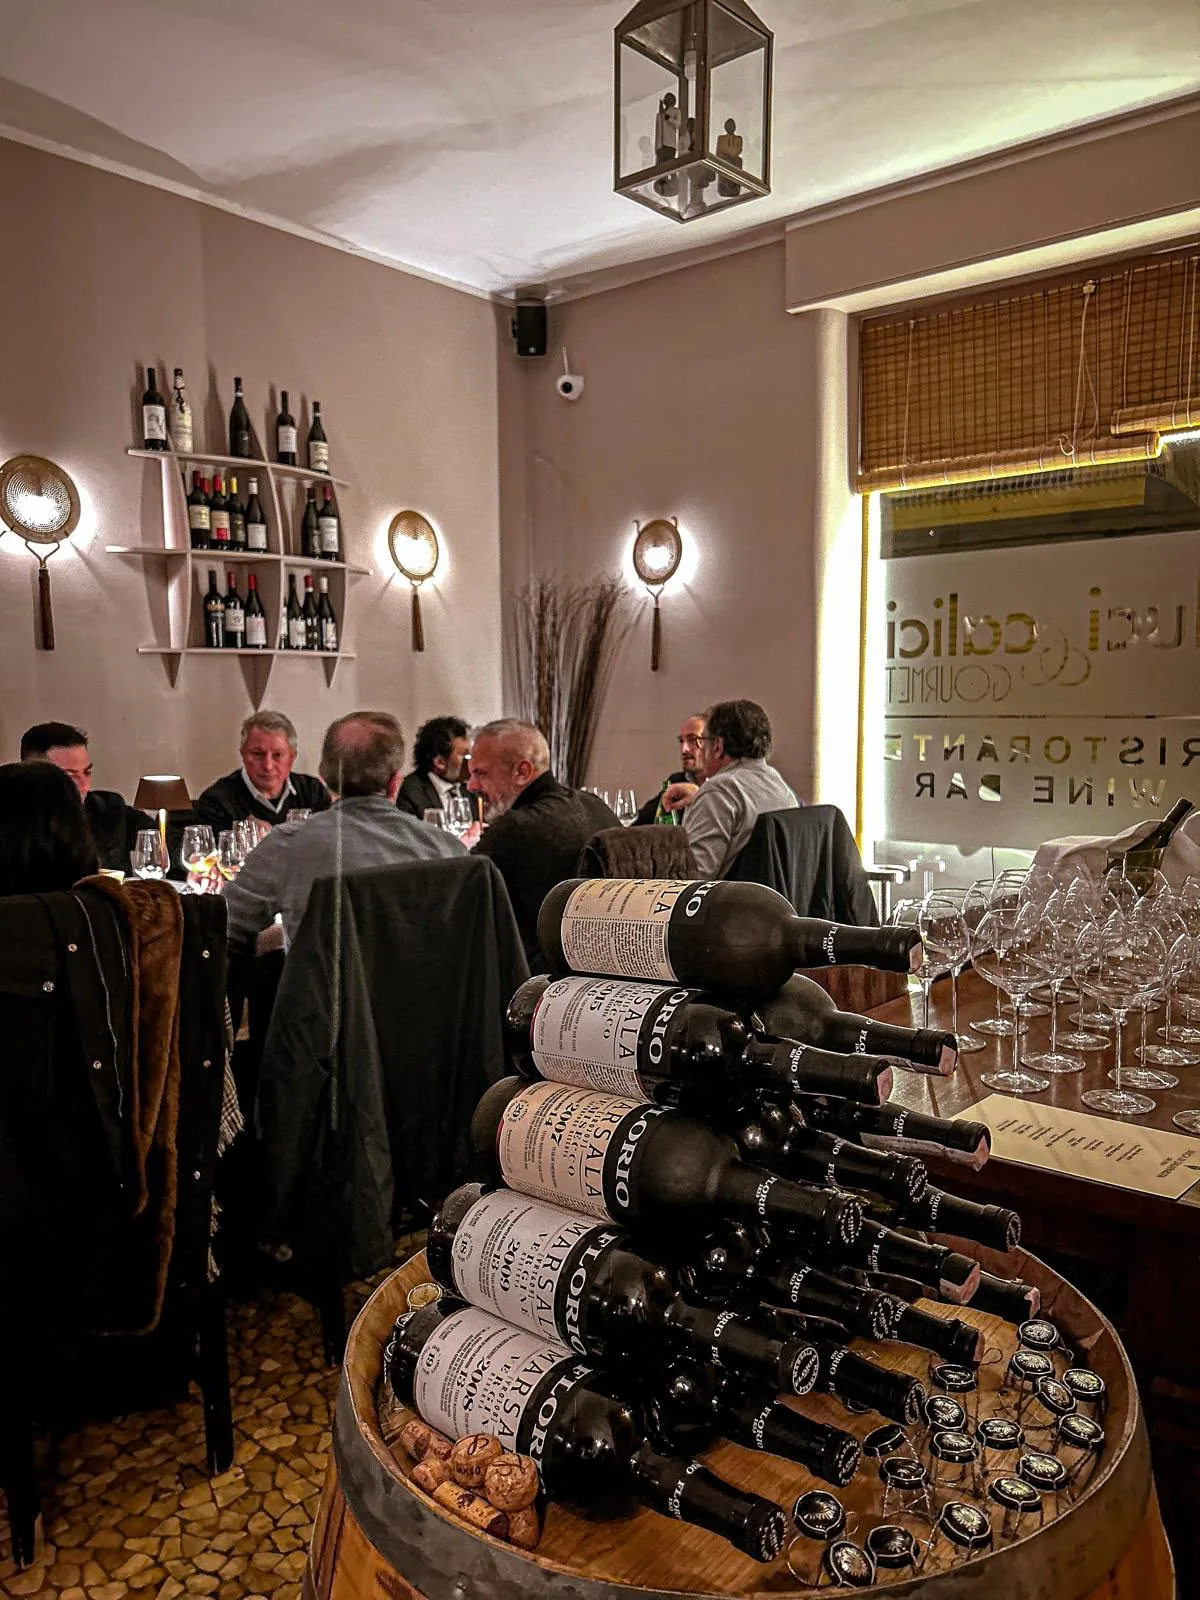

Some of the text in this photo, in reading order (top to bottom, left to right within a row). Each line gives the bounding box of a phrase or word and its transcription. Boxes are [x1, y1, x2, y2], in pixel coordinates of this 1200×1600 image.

[589, 983, 620, 1012] 2015
[619, 985, 660, 1060] RSALA
[649, 989, 689, 1064] ORIO
[512, 1104, 524, 1118] 29
[545, 1111, 558, 1127] 14
[551, 1103, 579, 1147] 2007
[585, 1101, 633, 1197] ARSALA
[615, 1107, 665, 1208] LORIO
[758, 1176, 778, 1215] FLORIO
[492, 1253, 501, 1271] 13
[500, 1238, 521, 1292] 2009
[565, 1232, 619, 1356] FLORIO
[791, 1266, 812, 1303] FLORIO
[425, 1351, 437, 1368] 19
[456, 1370, 468, 1389] 13
[463, 1356, 491, 1413] 2008
[481, 1354, 521, 1426] VERGIN
[755, 1406, 771, 1449] FLORIO
